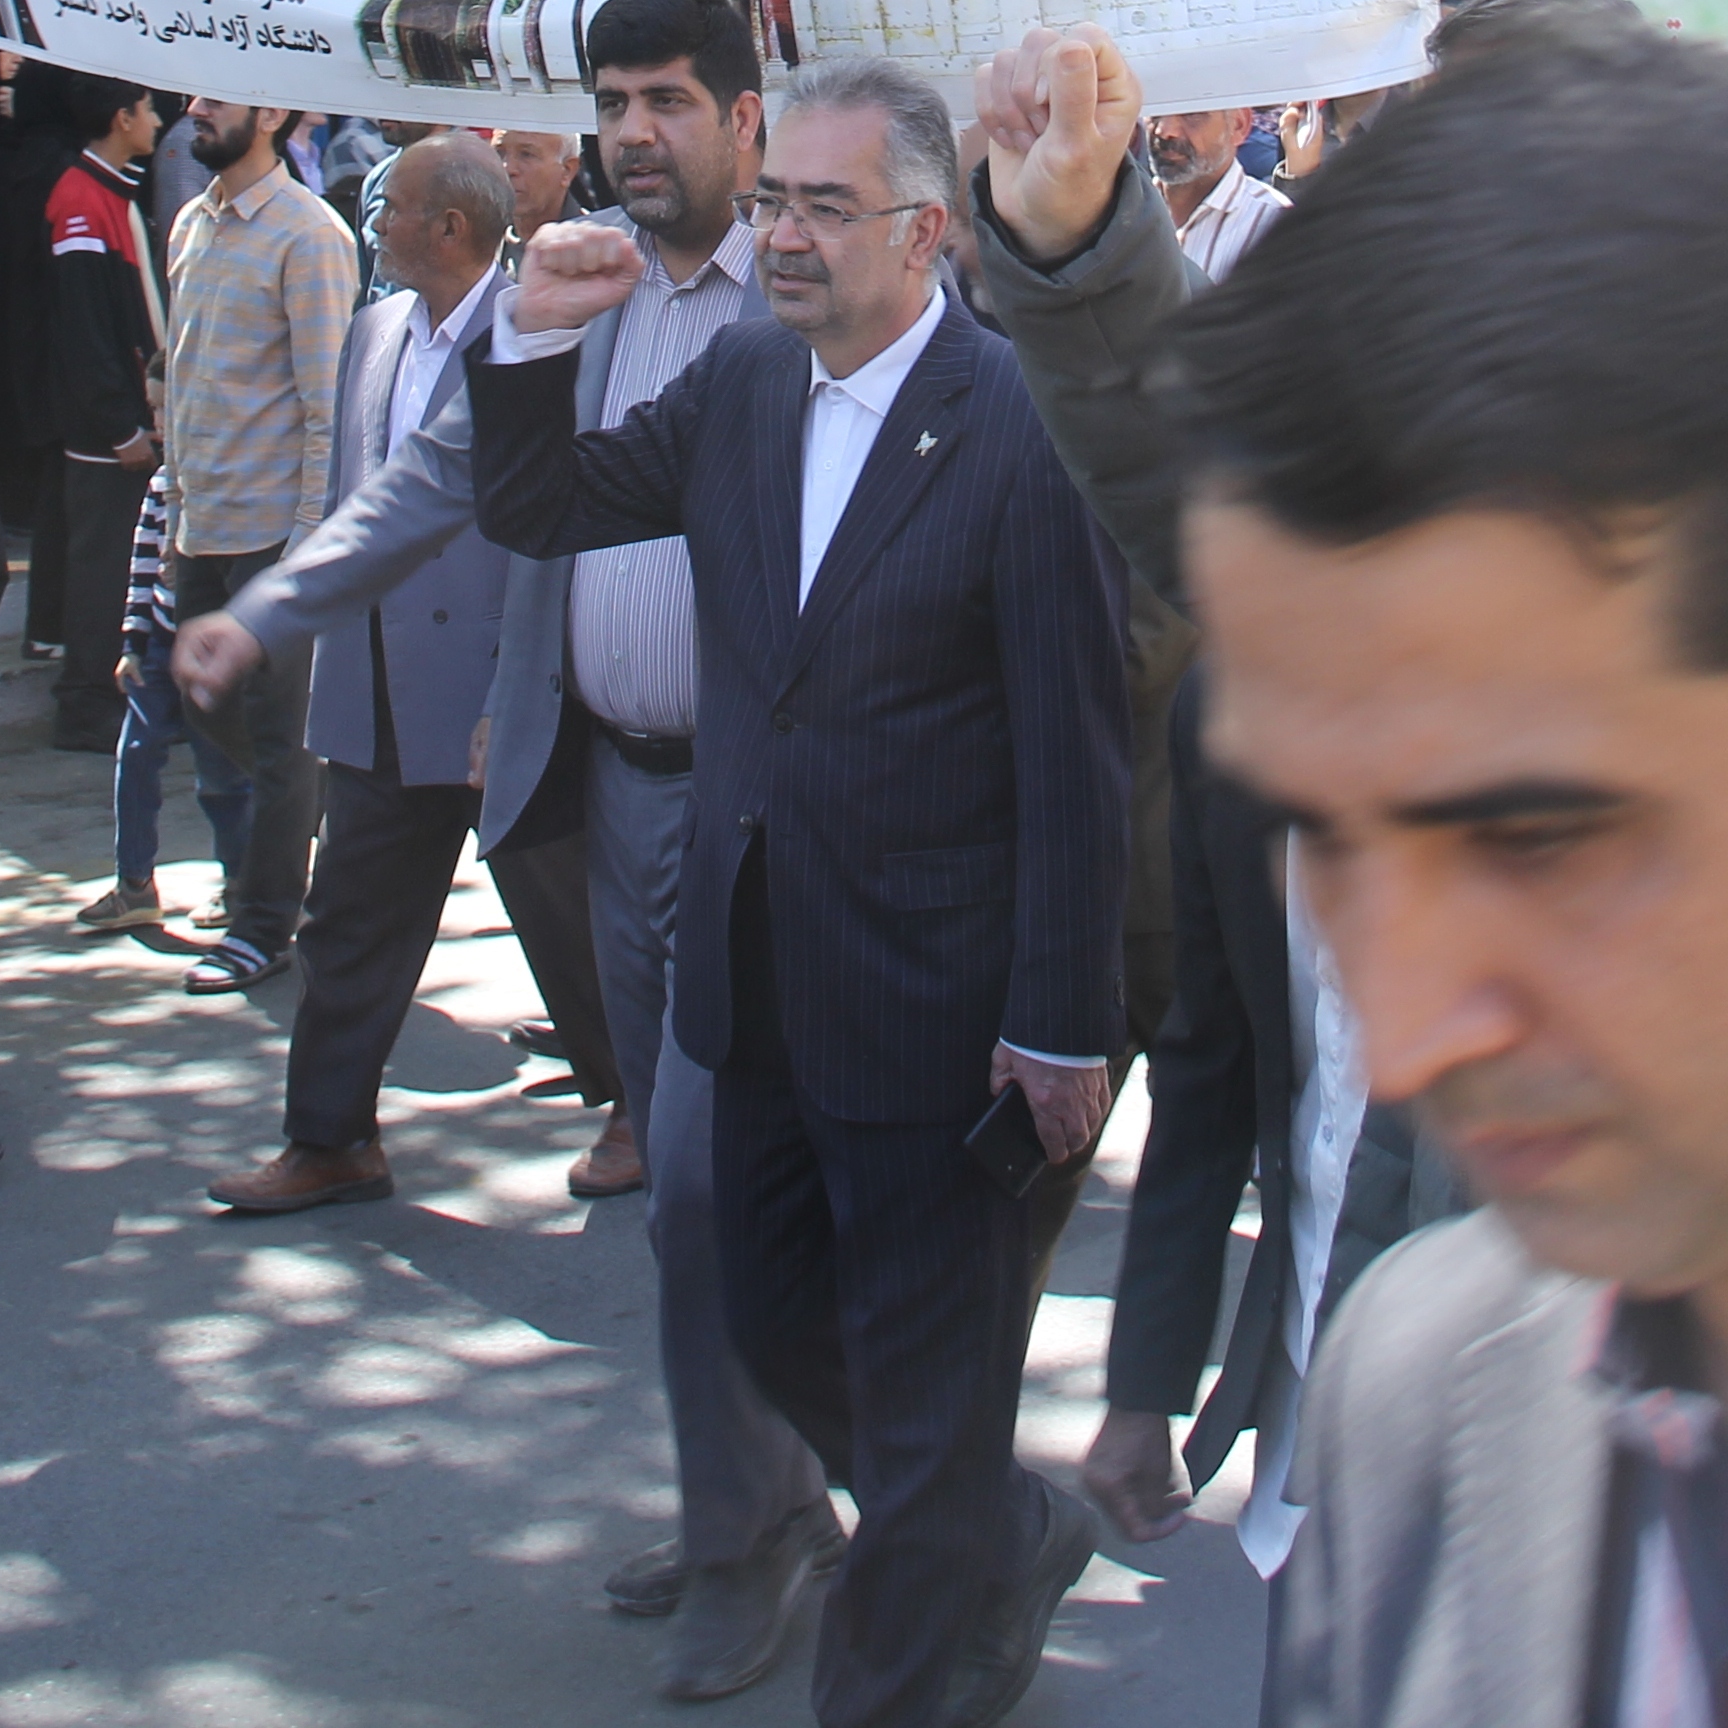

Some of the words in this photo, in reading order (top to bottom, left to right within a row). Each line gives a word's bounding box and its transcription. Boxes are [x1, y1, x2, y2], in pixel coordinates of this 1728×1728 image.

[105, 0, 150, 36] واحد
[152, 11, 219, 44] اسلامی
[221, 15, 252, 50] آزاد
[256, 20, 333, 55] دانشگاه
